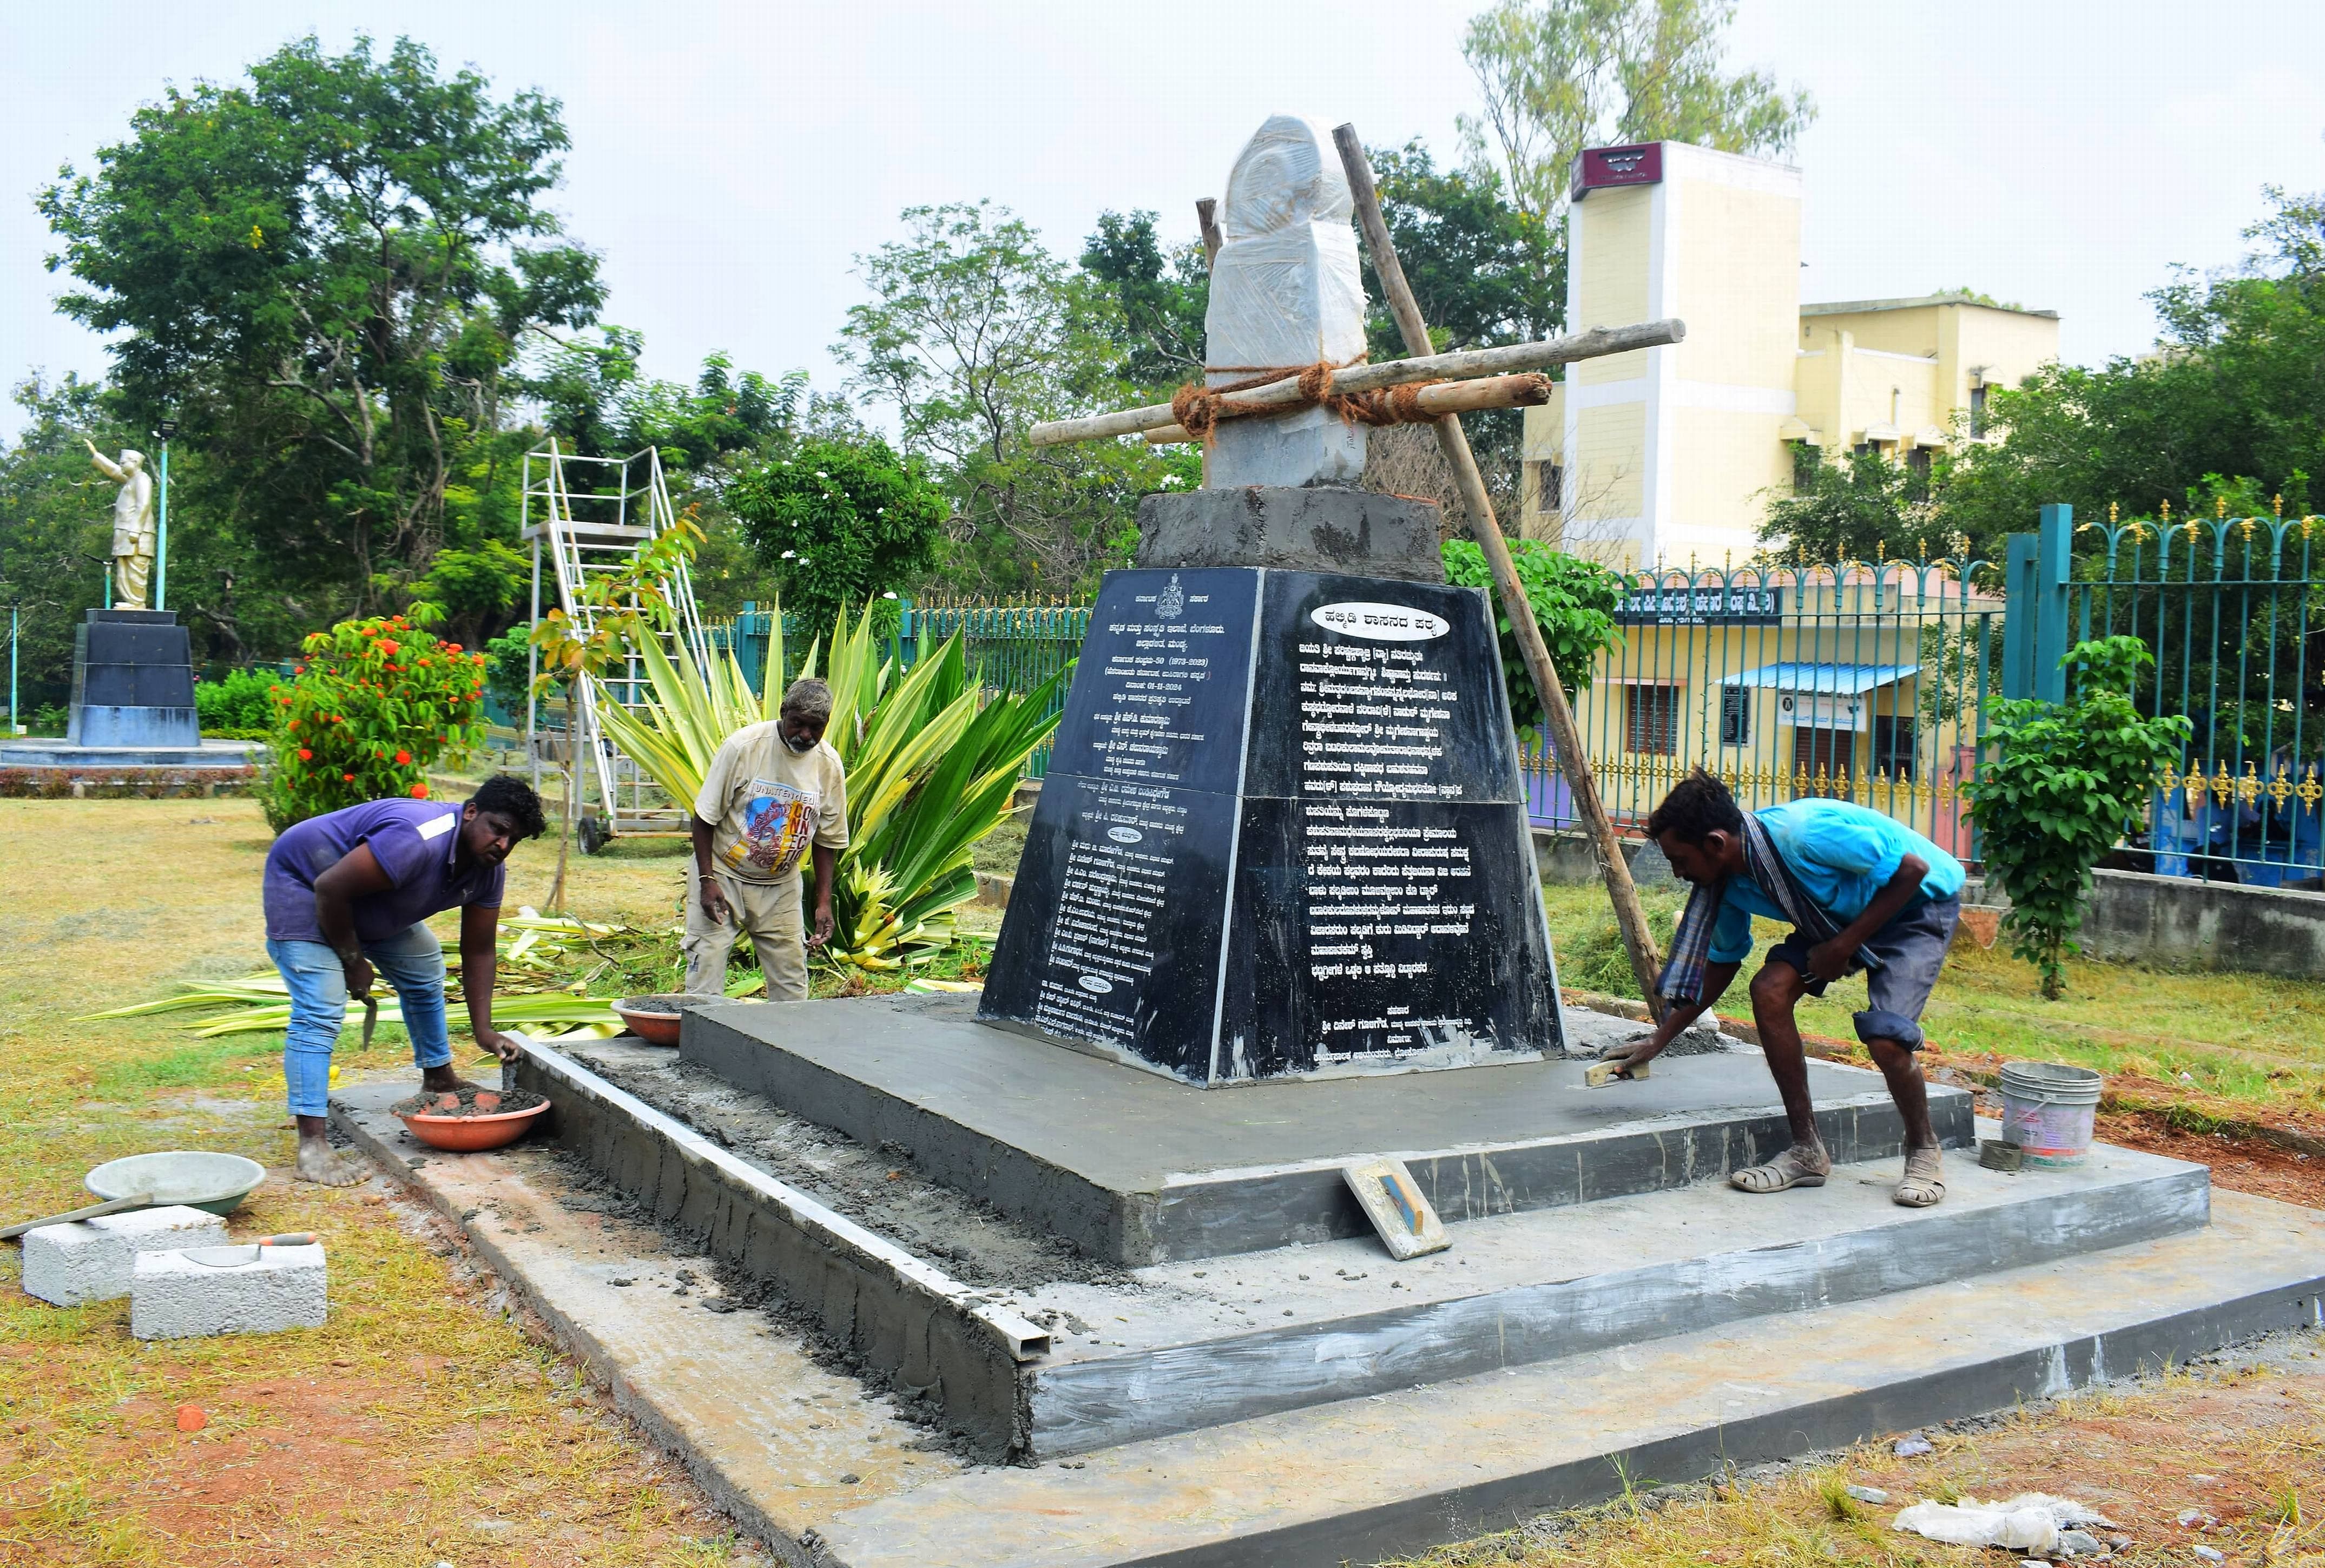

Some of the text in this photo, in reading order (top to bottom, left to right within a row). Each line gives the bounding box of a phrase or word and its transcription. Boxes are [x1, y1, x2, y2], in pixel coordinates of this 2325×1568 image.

[1364, 614, 1408, 628] ಶಾಸನದ
[1109, 623, 1125, 634] ಕನ್ನಡ
[1169, 656, 1208, 667] (1973-2023)
[1147, 682, 1182, 690] 01-11-2024
[1113, 711, 1121, 724] ಶ್ರೀ
[1322, 1020, 1331, 1034] ಶ್ರೀ
[1333, 1018, 1356, 1030] ದಿನೇಶ್
